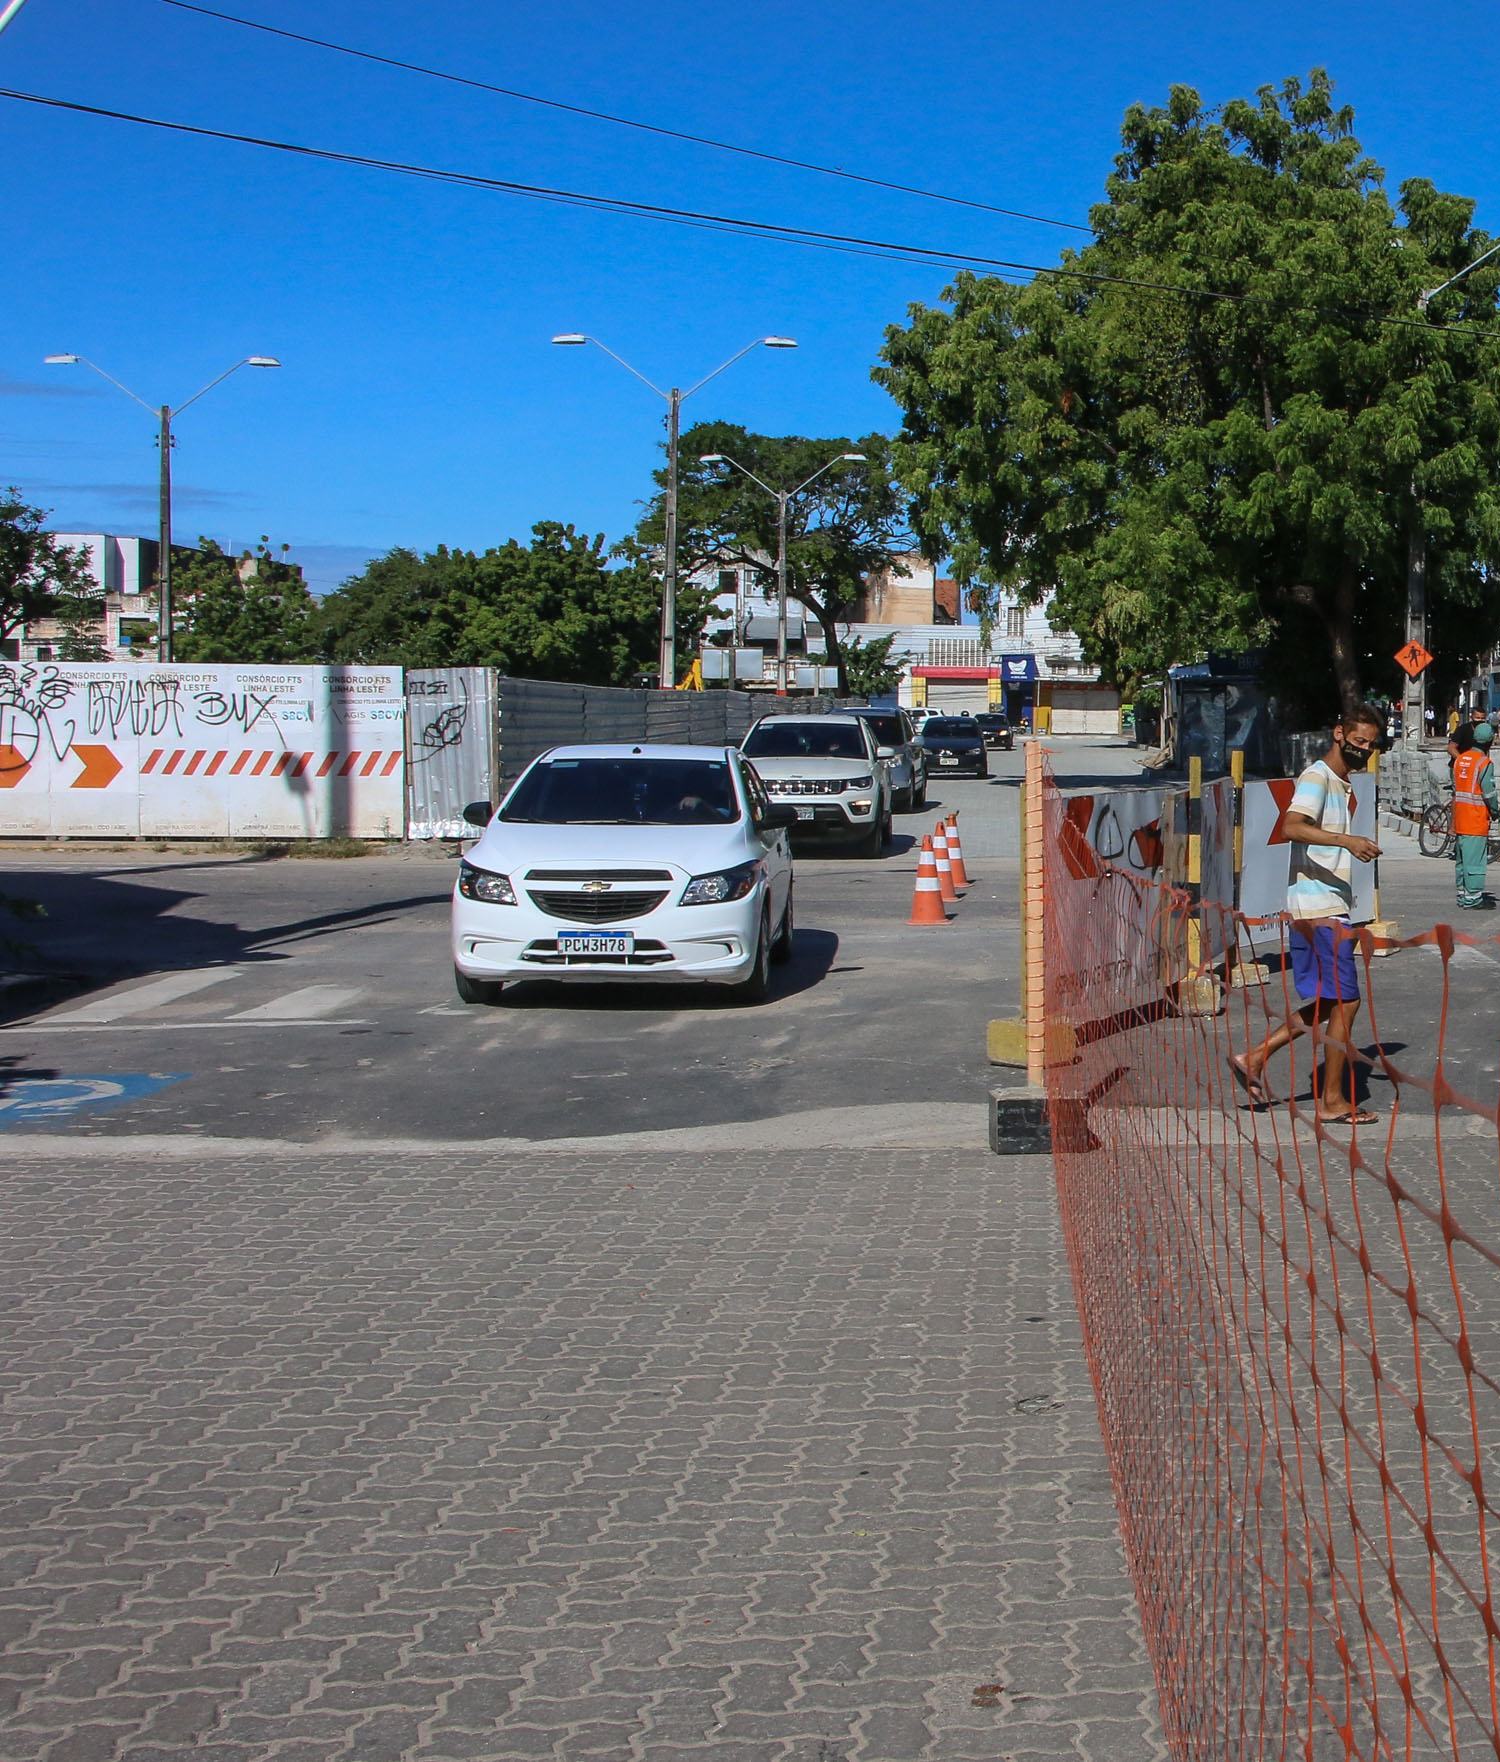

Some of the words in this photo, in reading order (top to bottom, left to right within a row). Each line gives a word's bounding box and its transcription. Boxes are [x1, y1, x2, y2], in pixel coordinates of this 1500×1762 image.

[112, 672, 128, 680] FTS
[202, 675, 218, 683] FTS
[287, 676, 302, 684] FTS
[375, 676, 391, 685] FTS
[183, 684, 210, 692] LESTE
[243, 685, 267, 693] LINHA
[330, 685, 355, 693] LINHA
[357, 685, 385, 693] LESTE
[564, 939, 625, 952] PCW3H78
